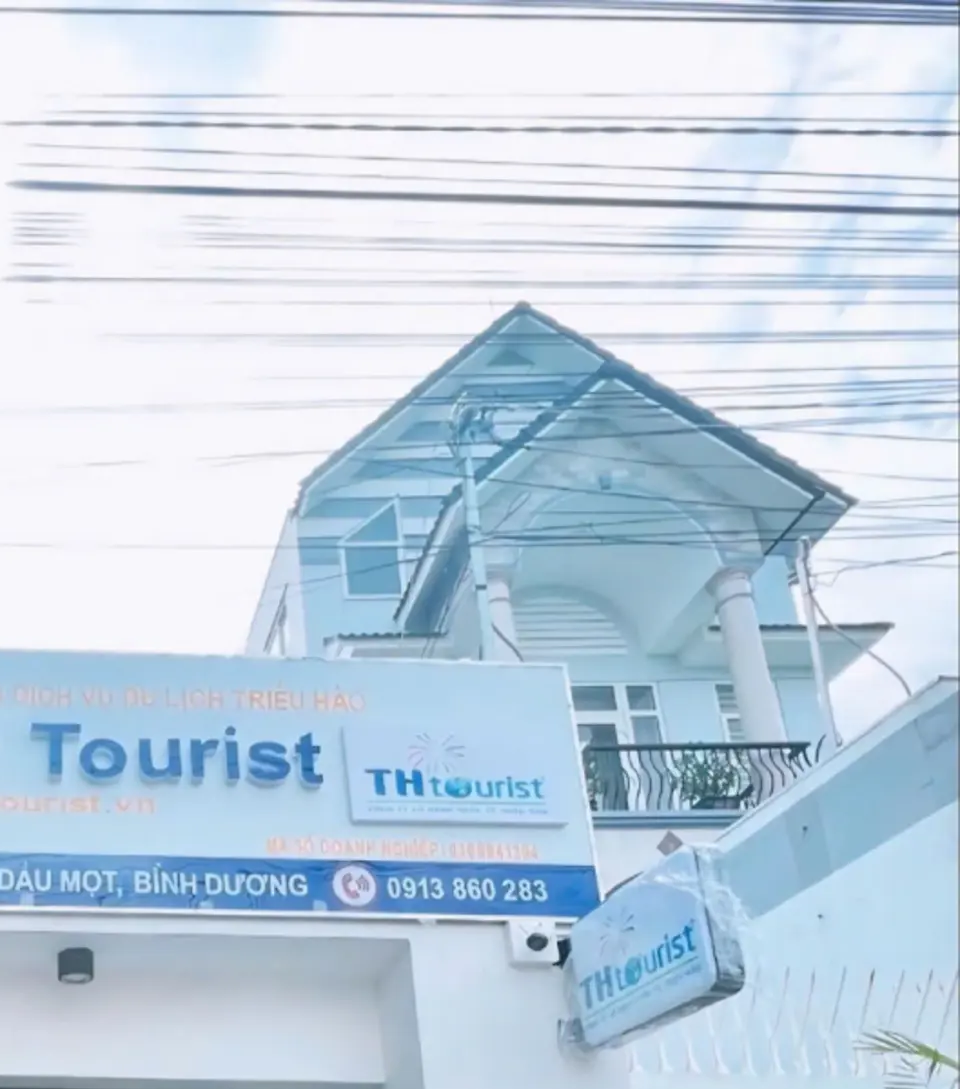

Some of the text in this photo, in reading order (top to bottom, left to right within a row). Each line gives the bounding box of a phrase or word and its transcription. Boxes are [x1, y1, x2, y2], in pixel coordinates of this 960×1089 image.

[30, 722, 324, 785] Tourist
[134, 863, 197, 896] BÌNH
[205, 872, 309, 897] DƯƠNG
[386, 876, 549, 902] 0913 860 283
